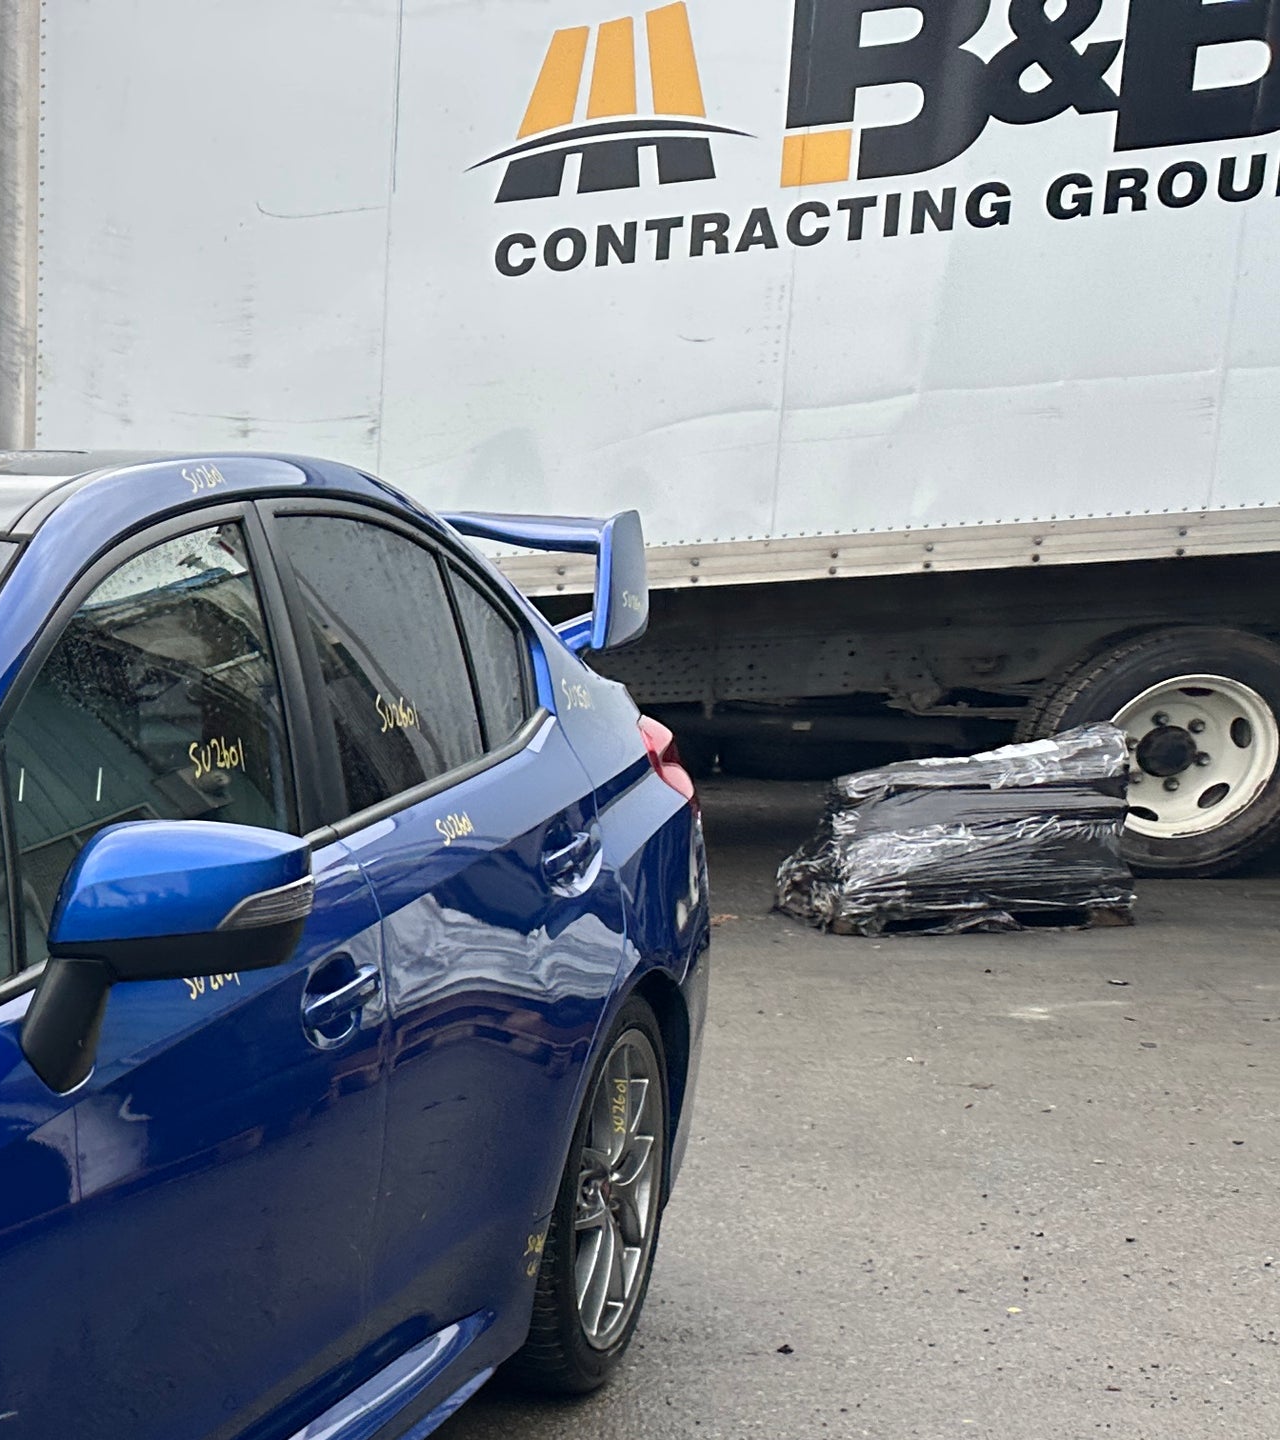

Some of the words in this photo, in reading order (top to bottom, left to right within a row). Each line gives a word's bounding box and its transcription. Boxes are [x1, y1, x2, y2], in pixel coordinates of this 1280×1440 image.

[493, 180, 1012, 277] CONTRACTING
[1045, 152, 1280, 220] GROU
[188, 735, 246, 779] SU2601
